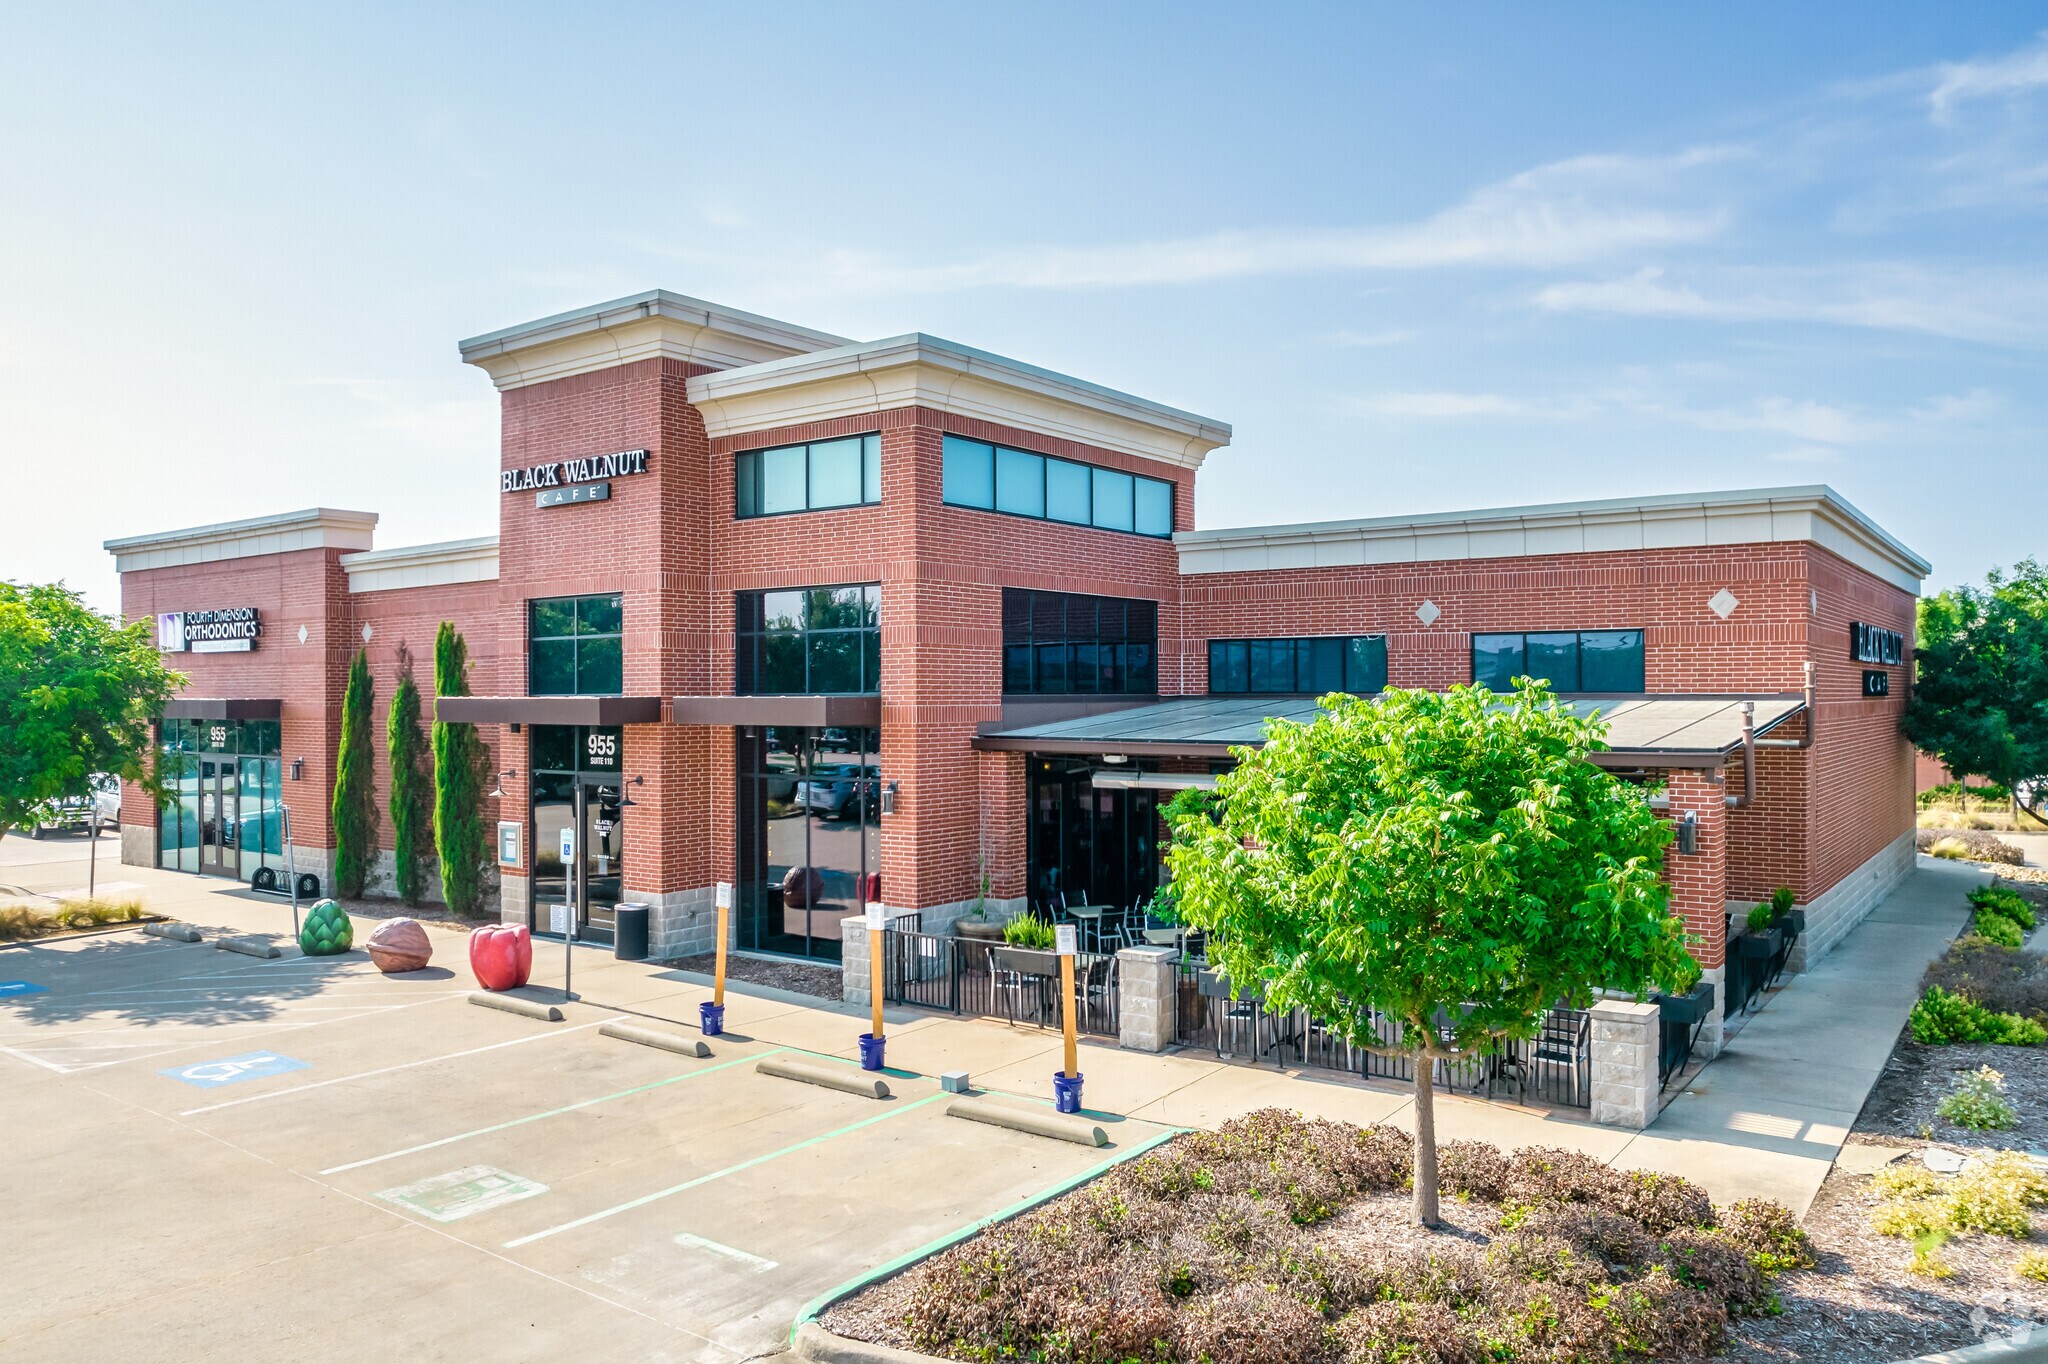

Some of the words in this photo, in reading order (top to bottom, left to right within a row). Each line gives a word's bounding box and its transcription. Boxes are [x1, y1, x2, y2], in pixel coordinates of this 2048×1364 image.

[501, 462, 559, 493] BLACK
[563, 449, 645, 483] WALNUT
[186, 611, 213, 624] FOURTH
[184, 621, 256, 641] ORTHODONTICS
[210, 726, 226, 742] 955
[588, 735, 615, 755] 955
[590, 756, 604, 765] SUITE
